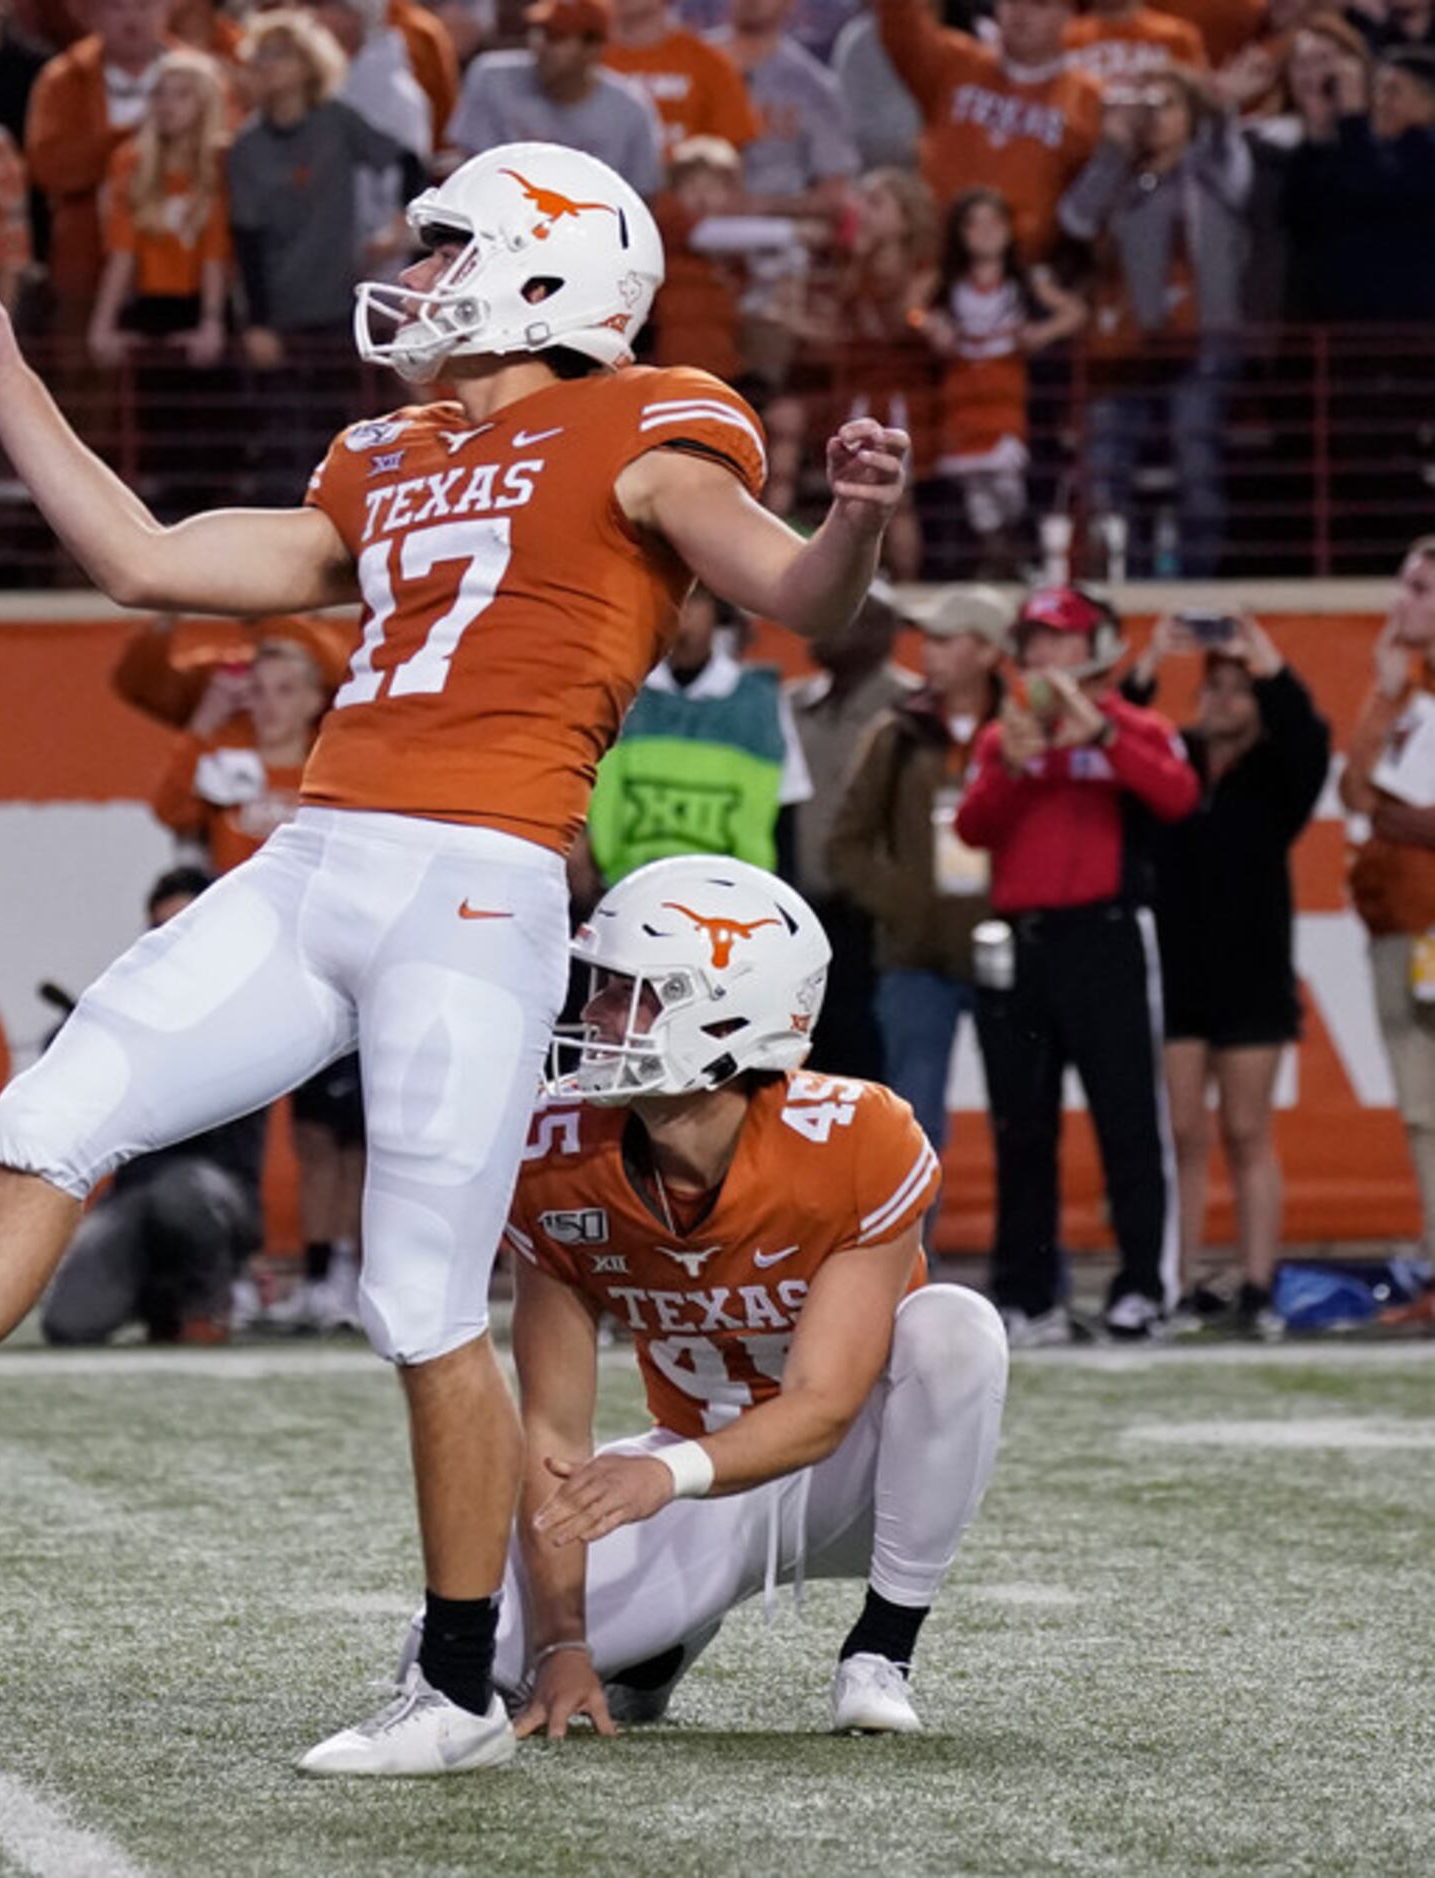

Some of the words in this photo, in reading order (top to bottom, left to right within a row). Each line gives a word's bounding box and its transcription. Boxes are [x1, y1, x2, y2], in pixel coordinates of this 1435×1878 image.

[361, 458, 545, 543] TEXAS
[332, 515, 512, 710] 17
[780, 1076, 866, 1143] 45
[541, 1210, 604, 1242] 150
[607, 1279, 809, 1332] TEXAS
